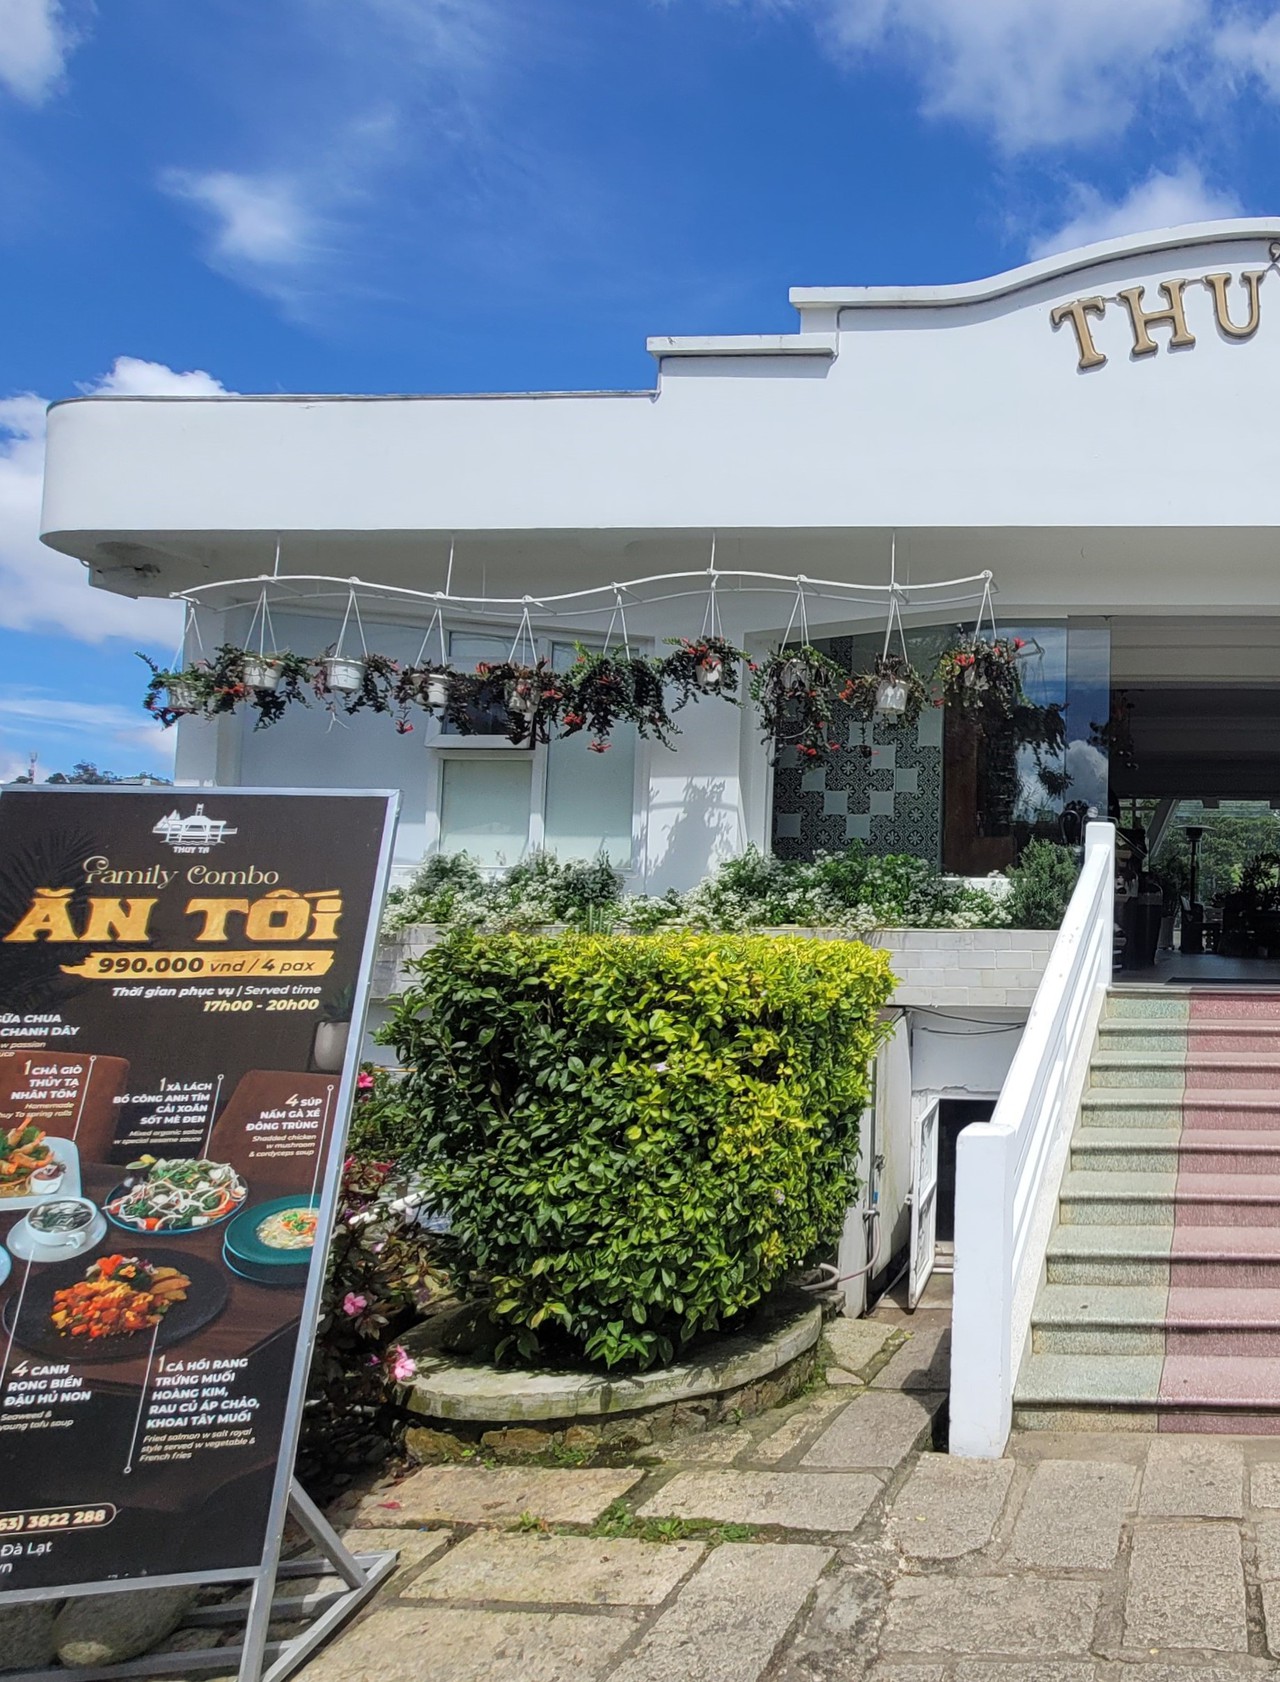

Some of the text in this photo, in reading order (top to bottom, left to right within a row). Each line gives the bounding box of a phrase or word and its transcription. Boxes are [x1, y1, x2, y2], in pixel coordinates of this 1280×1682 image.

[82, 855, 279, 889] Family Combo
[2, 887, 343, 943] ĂN TỐI
[97, 957, 315, 974] 990.000 vnd 4 pax
[112, 985, 322, 998] Thời gian phục vụ Served time
[203, 1000, 319, 1012] 17h00 20h00
[24, 1015, 62, 1023] CHUA
[0, 1025, 80, 1036] CHANH DÂY
[10, 1041, 46, 1049] passion
[24, 1060, 32, 1076] 1
[60, 1064, 82, 1074] GIÒ
[29, 1076, 79, 1088] THỦY TẠ
[160, 1077, 212, 1091] 1 XÀ LÁCH
[11, 1088, 77, 1100] NHÂN TÔM
[132, 1092, 211, 1103] CÔNG ANH TÍM
[285, 1093, 323, 1107] 4 SÚP
[156, 1104, 175, 1113] CẢI
[260, 1108, 304, 1119] NẤM GÀ
[140, 1114, 206, 1125] SỐT ĐEN
[245, 1120, 319, 1131] ĐÔNG TRÙNG
[287, 1133, 317, 1141] chicken
[256, 1150, 294, 1158] cordyceps
[11, 1360, 70, 1377] 4 CANH
[158, 1354, 249, 1373] 1 CÁ RANG
[156, 1370, 236, 1387] TRỨNG MUỐI
[7, 1380, 48, 1392] RONG
[4, 1390, 92, 1407] ĐẬU HỦ NON
[152, 1386, 229, 1401] HOÀNG KIM,
[149, 1396, 260, 1415] RAU CỦ ÁP CHẢO,
[1, 1411, 45, 1420] Seaweed
[146, 1410, 252, 1429] KHOAI TÂY MUỐI
[143, 1428, 253, 1444] Fried royal
[163, 1438, 248, 1451] served vegetable
[139, 1452, 170, 1462] French
[27, 1509, 106, 1529] 3822 288
[0, 1541, 53, 1557] Đà Lạt
